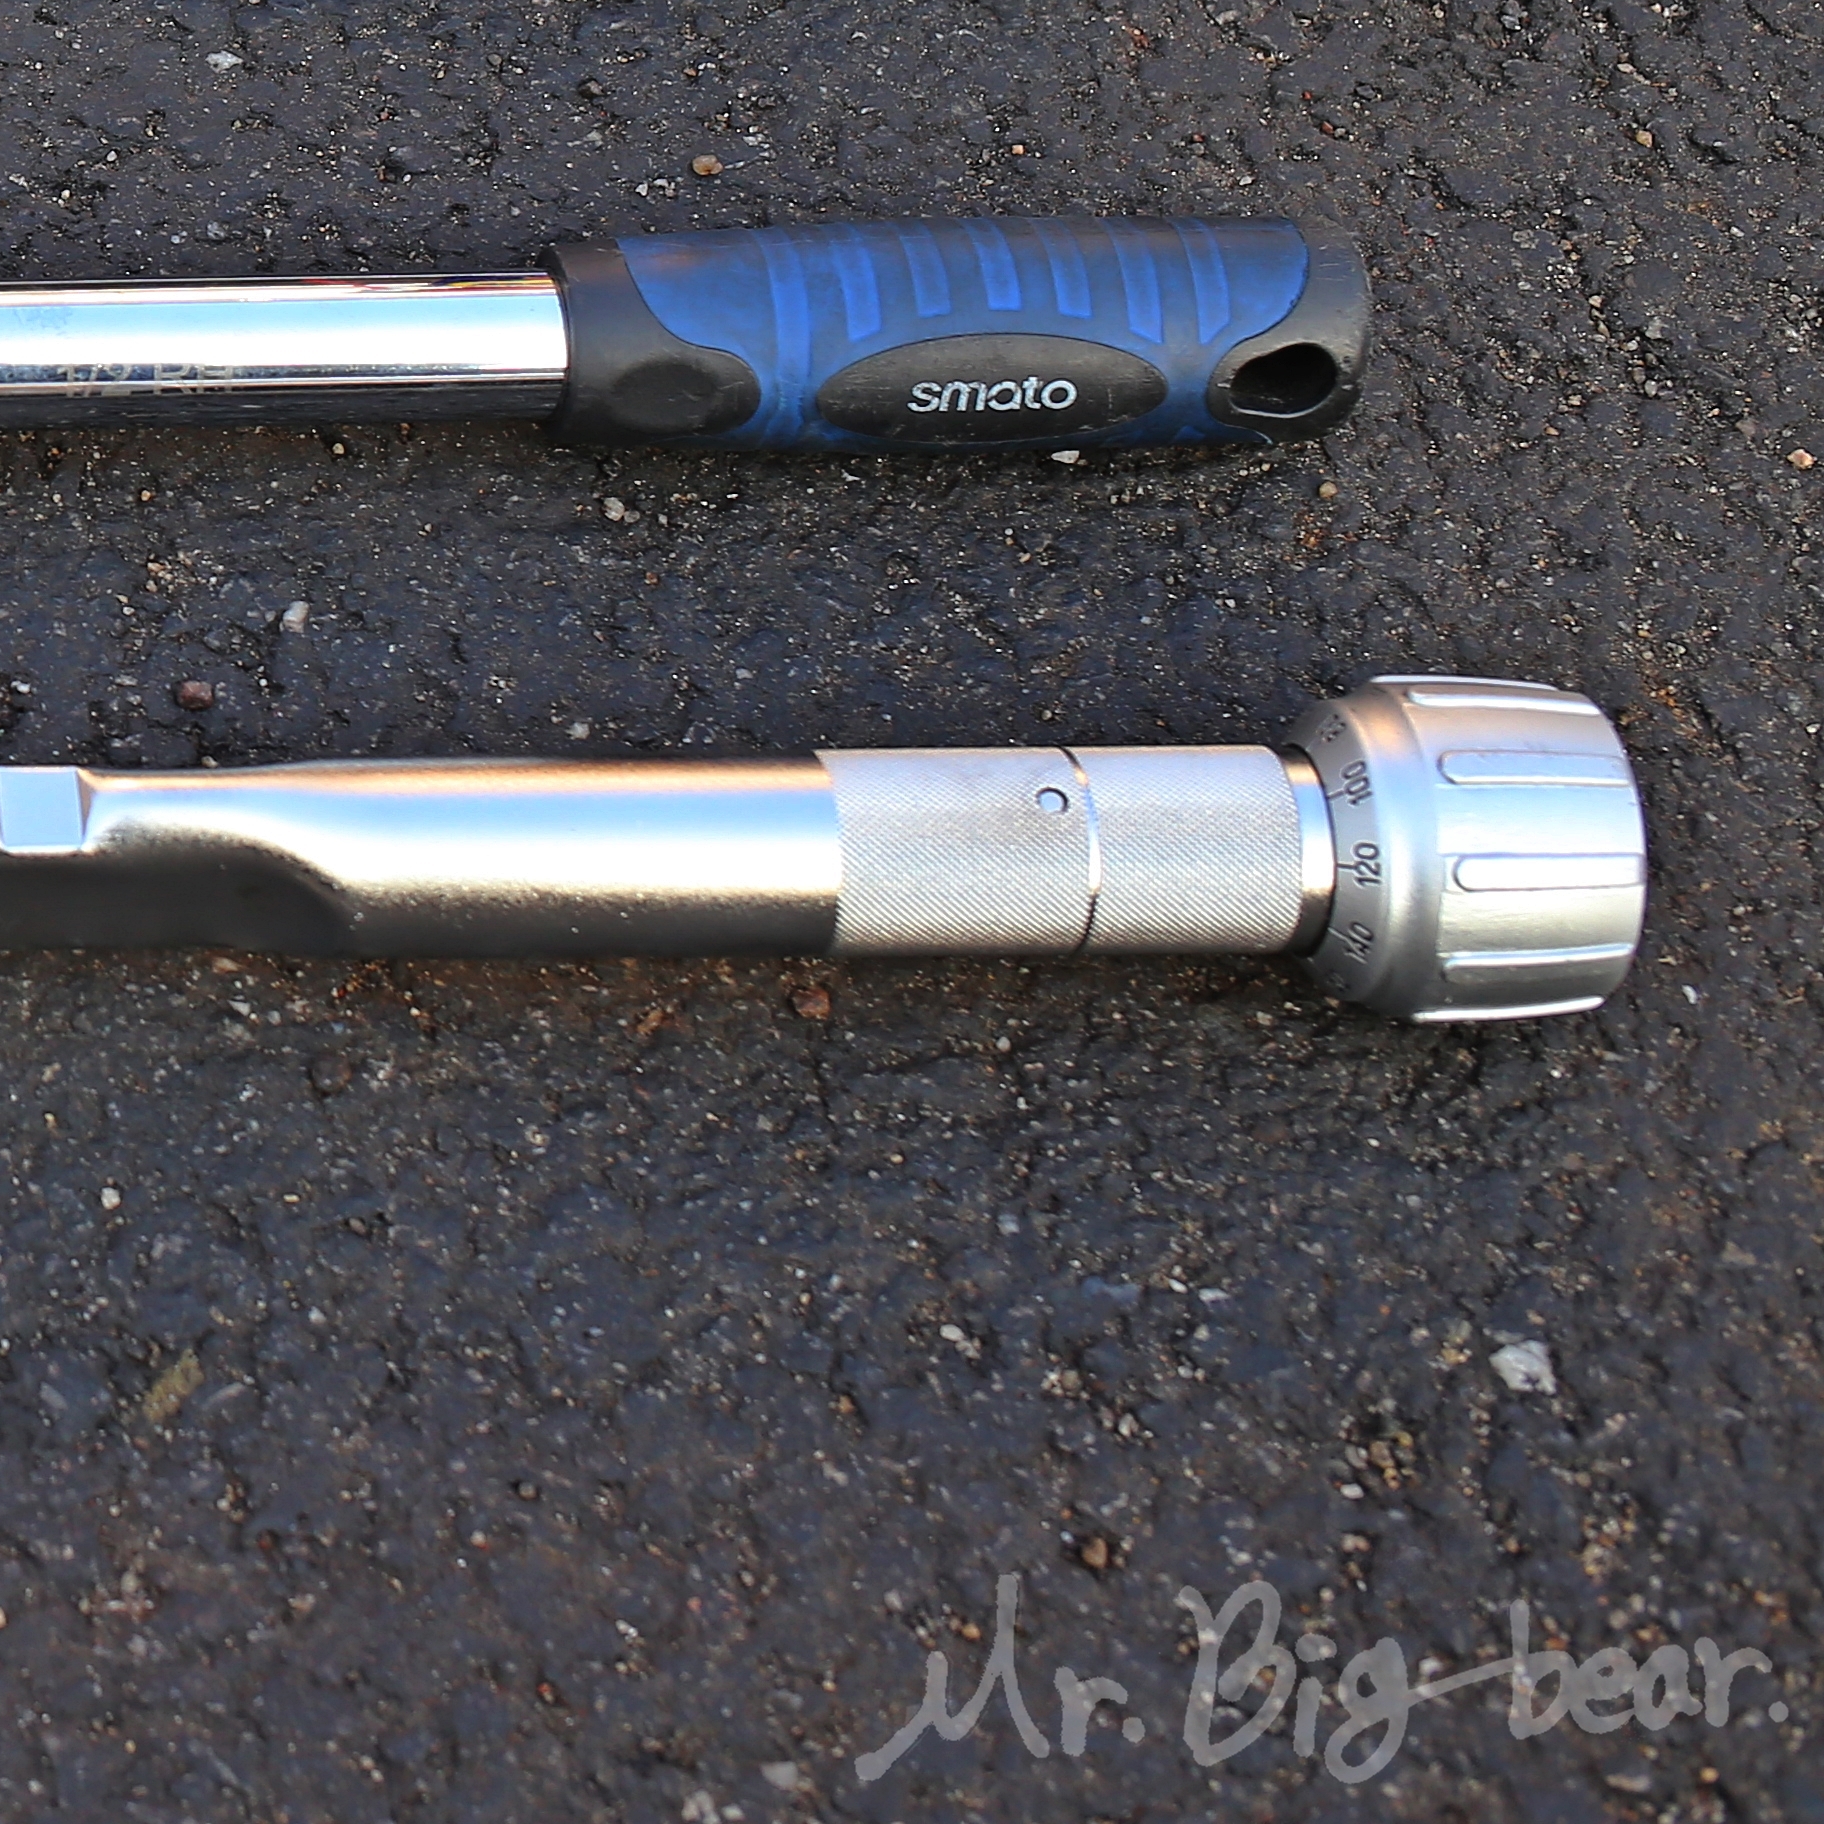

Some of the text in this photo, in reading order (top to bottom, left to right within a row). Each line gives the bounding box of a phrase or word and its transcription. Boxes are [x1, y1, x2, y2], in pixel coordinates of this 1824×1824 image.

[907, 376, 1079, 412] smato
[1340, 760, 1373, 806] 100
[1352, 842, 1382, 887] 120
